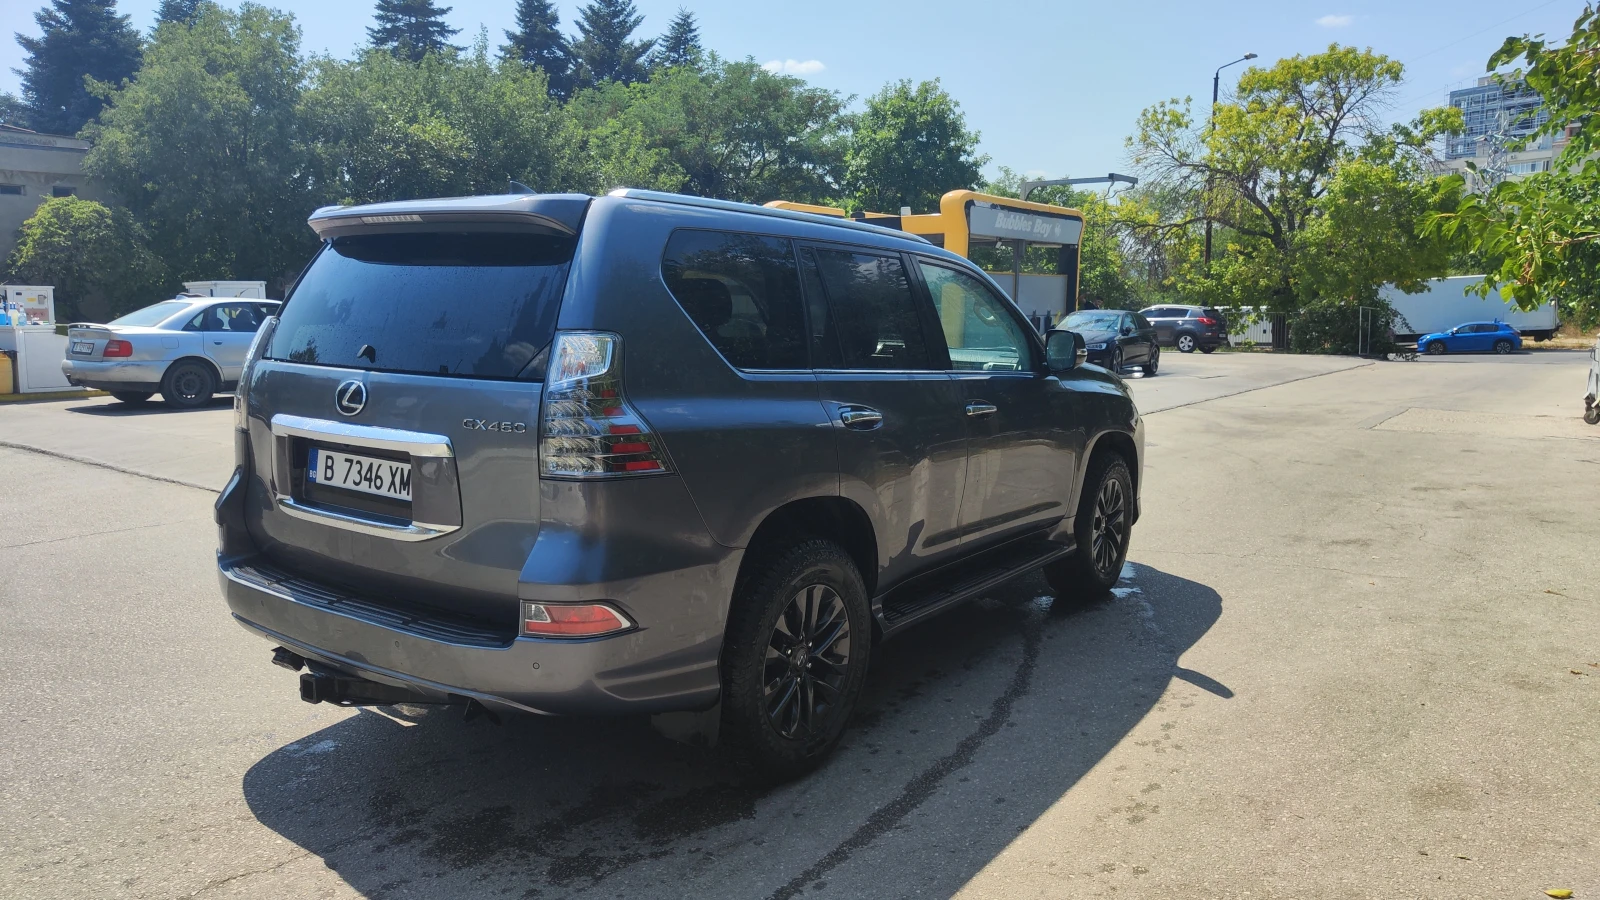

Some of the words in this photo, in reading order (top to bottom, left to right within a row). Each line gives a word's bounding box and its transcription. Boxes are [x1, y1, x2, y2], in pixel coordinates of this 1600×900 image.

[995, 213, 1032, 232] Bubbles
[1033, 219, 1053, 237] Bay
[309, 469, 317, 479] BG
[324, 455, 335, 481] B
[343, 458, 384, 490] 7346
[387, 465, 411, 496] XM
